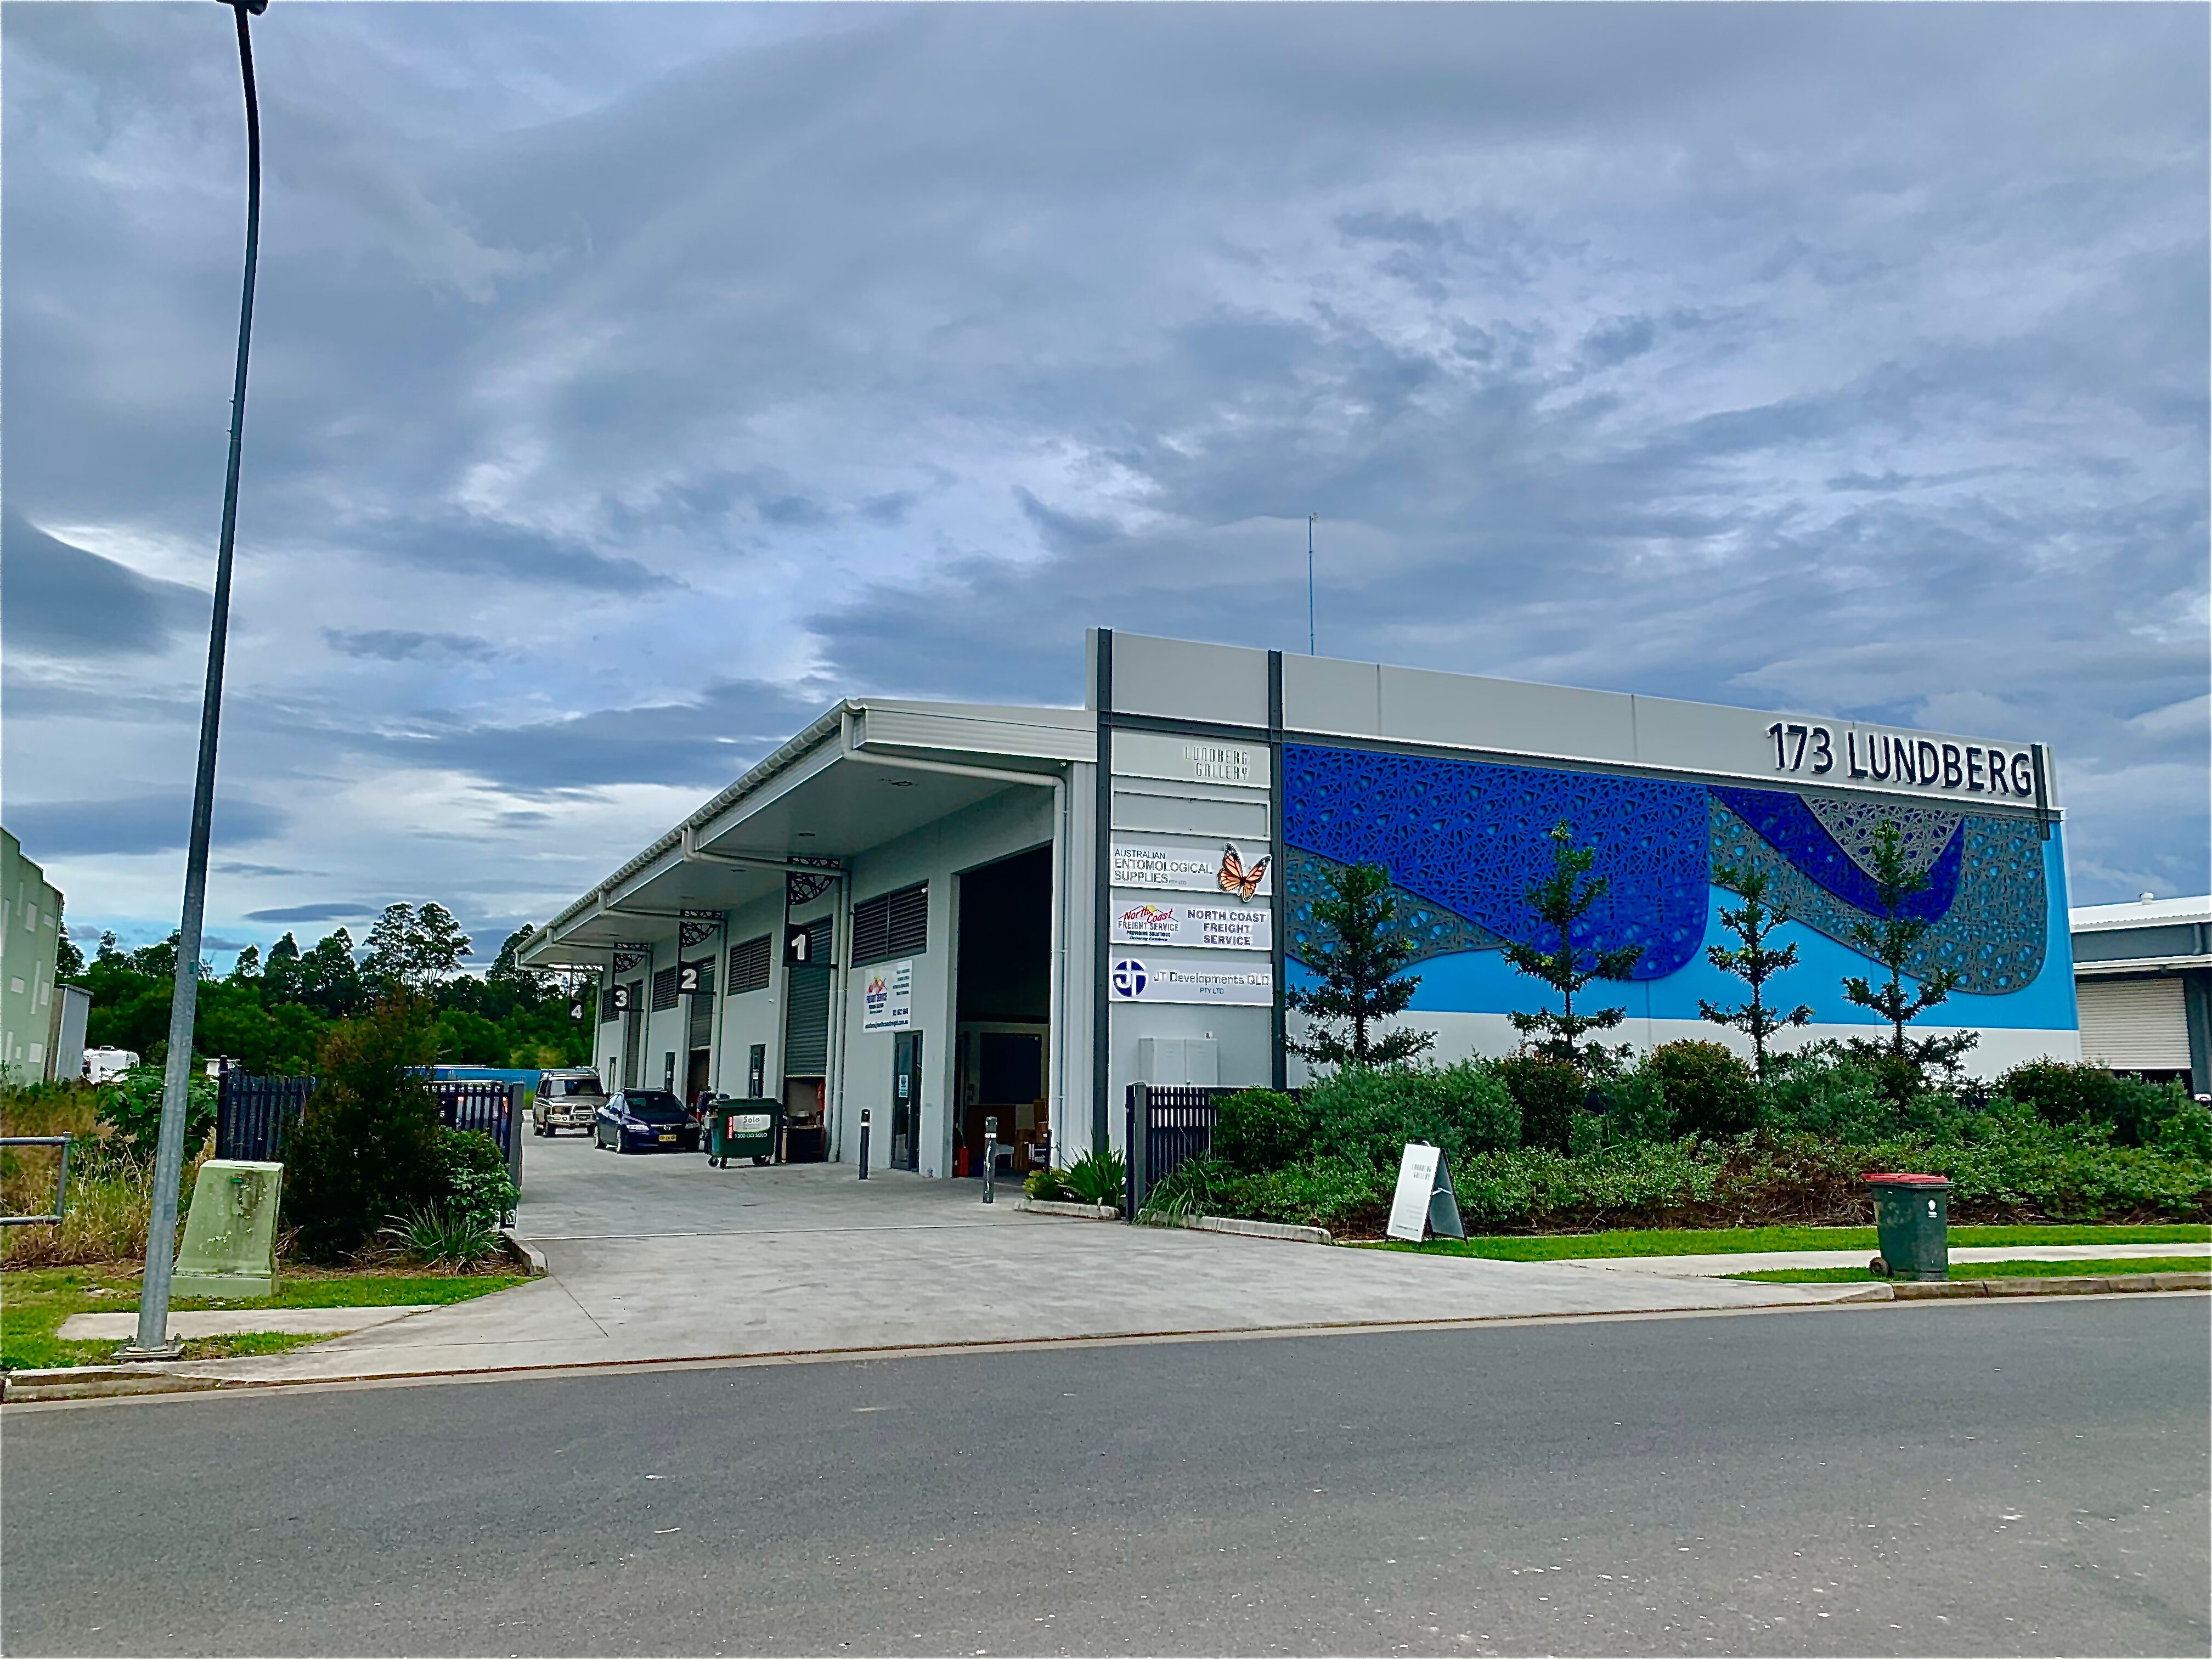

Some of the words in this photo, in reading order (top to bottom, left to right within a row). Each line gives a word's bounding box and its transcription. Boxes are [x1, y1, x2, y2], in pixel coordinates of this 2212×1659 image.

[1185, 746, 1247, 765] LUNDBERG
[1768, 723, 1833, 773] 173
[1848, 731, 2033, 797] LUNDBERG
[1197, 763, 1248, 780] GALLERY
[1114, 849, 1165, 859] AUSTRALIAN
[1115, 858, 1212, 874] ENTOMOLOGICAL
[1114, 870, 1169, 883] SUPPLIES
[1124, 906, 1151, 921] North
[1147, 908, 1173, 923] Coast
[1188, 910, 1226, 921] NORTH
[1230, 912, 1266, 922] COAST
[1118, 921, 1147, 930] FREIGHT
[1149, 923, 1178, 932] SERVICE
[1204, 923, 1250, 933] FREIGHT
[791, 934, 806, 960] 1
[1204, 935, 1251, 945] SERVICE
[681, 969, 697, 989] 2
[1153, 971, 1167, 981] JT
[1170, 972, 1244, 985] Developments
[1247, 975, 1269, 986] QLD
[615, 990, 627, 1007] 3
[571, 1005, 582, 1019] 4
